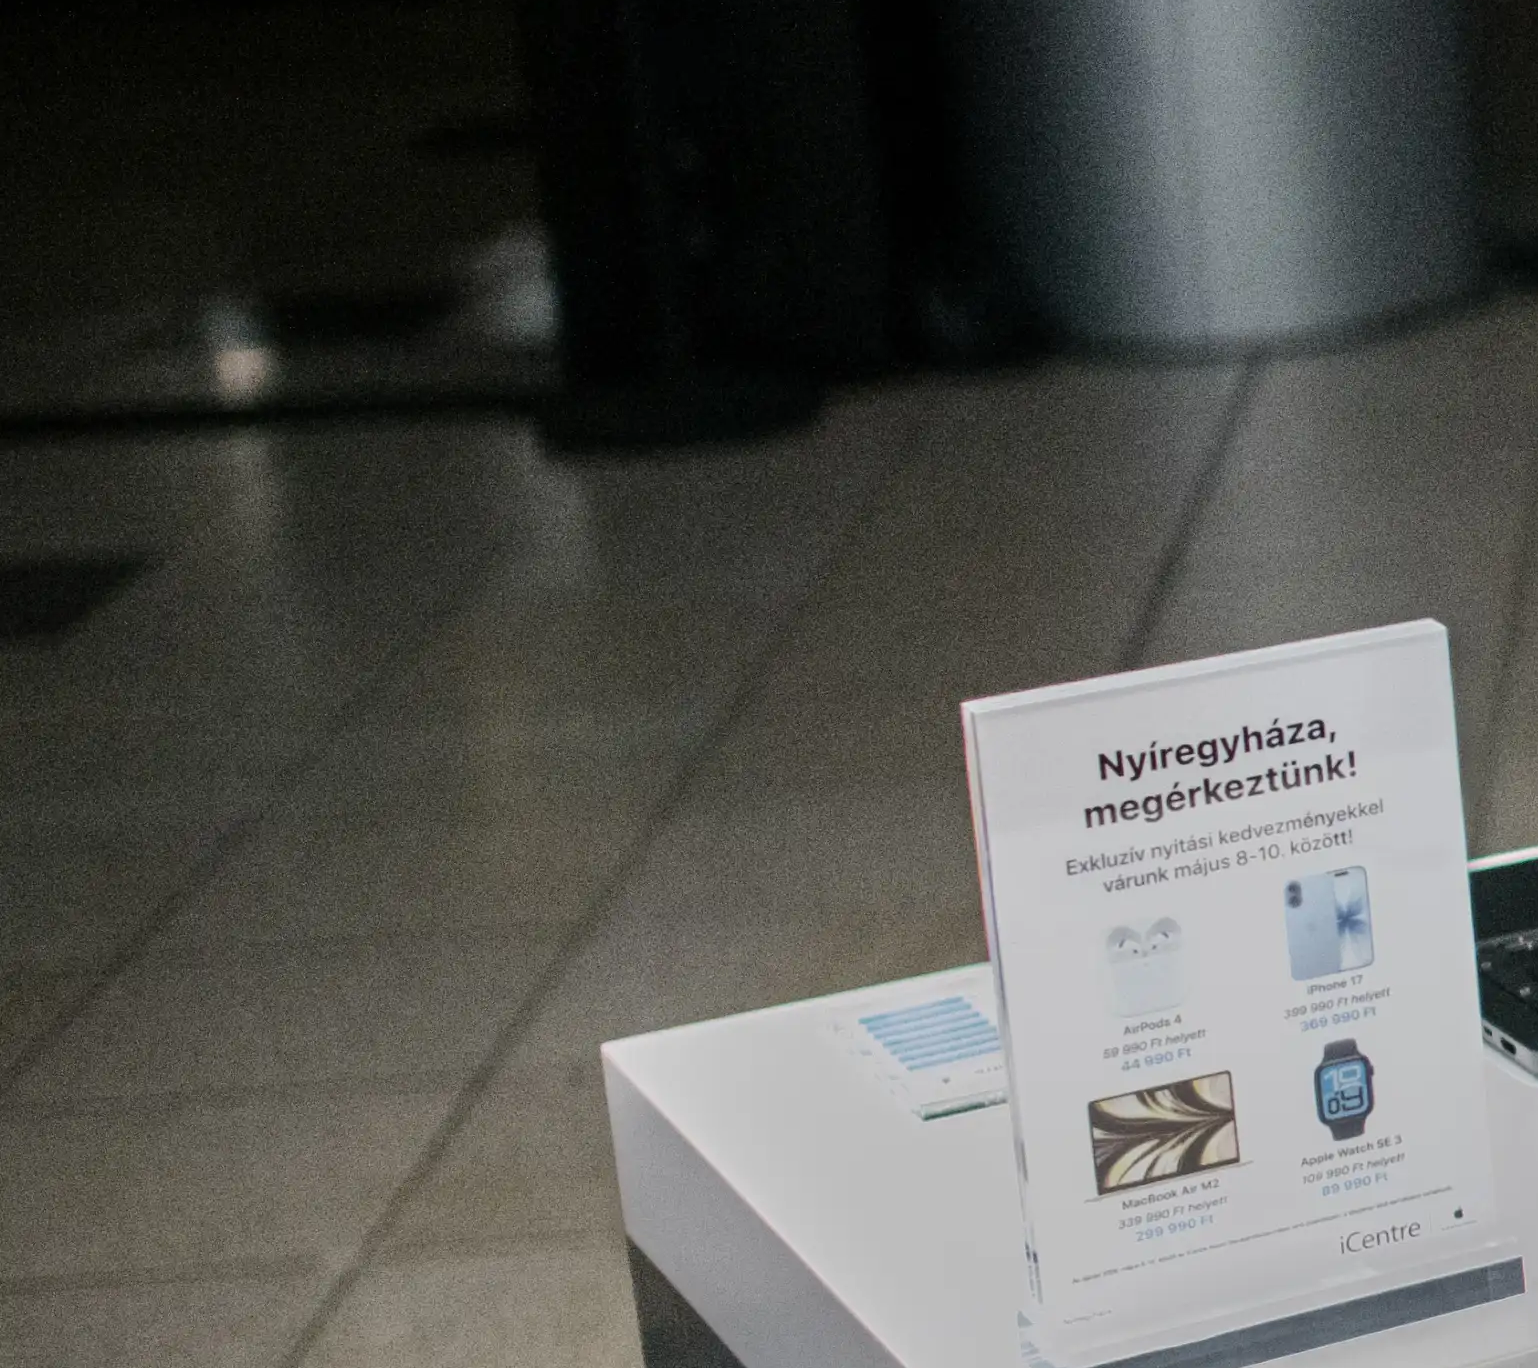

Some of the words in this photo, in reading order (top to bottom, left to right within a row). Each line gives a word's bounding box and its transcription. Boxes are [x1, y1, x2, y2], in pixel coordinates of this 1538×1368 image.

[1098, 717, 1336, 781] Nyíregyháza,
[1084, 751, 1357, 828] megérkeztünk!
[1066, 847, 1145, 876] Exkluzív
[1151, 831, 1214, 863] nyitási
[1218, 798, 1384, 845] kedvezményekkel
[1103, 865, 1170, 893] várunk
[1174, 856, 1231, 881] május
[1236, 845, 1286, 867] 8-10.
[1290, 829, 1354, 855] között!
[1307, 979, 1347, 995] iPhone
[1350, 974, 1363, 986] 17
[1336, 997, 1348, 1008] Ft
[1363, 1006, 1376, 1017] Ft
[1123, 1018, 1171, 1036] AirPods
[1174, 1014, 1182, 1025] 4
[1150, 1037, 1163, 1048] Ft
[1177, 1048, 1191, 1059] Ft
[1300, 1152, 1335, 1167] Apple
[1337, 1142, 1374, 1158] Watch
[1376, 1135, 1391, 1148] SE
[1352, 1162, 1364, 1173] Ft
[1375, 1172, 1388, 1183] Ft
[1122, 1189, 1178, 1210] MacBook
[1182, 1185, 1198, 1196] Air
[1201, 1178, 1220, 1191] M2
[1173, 1205, 1185, 1216] Ft
[1200, 1214, 1214, 1225] Ft
[1340, 1221, 1422, 1255] iCentre
